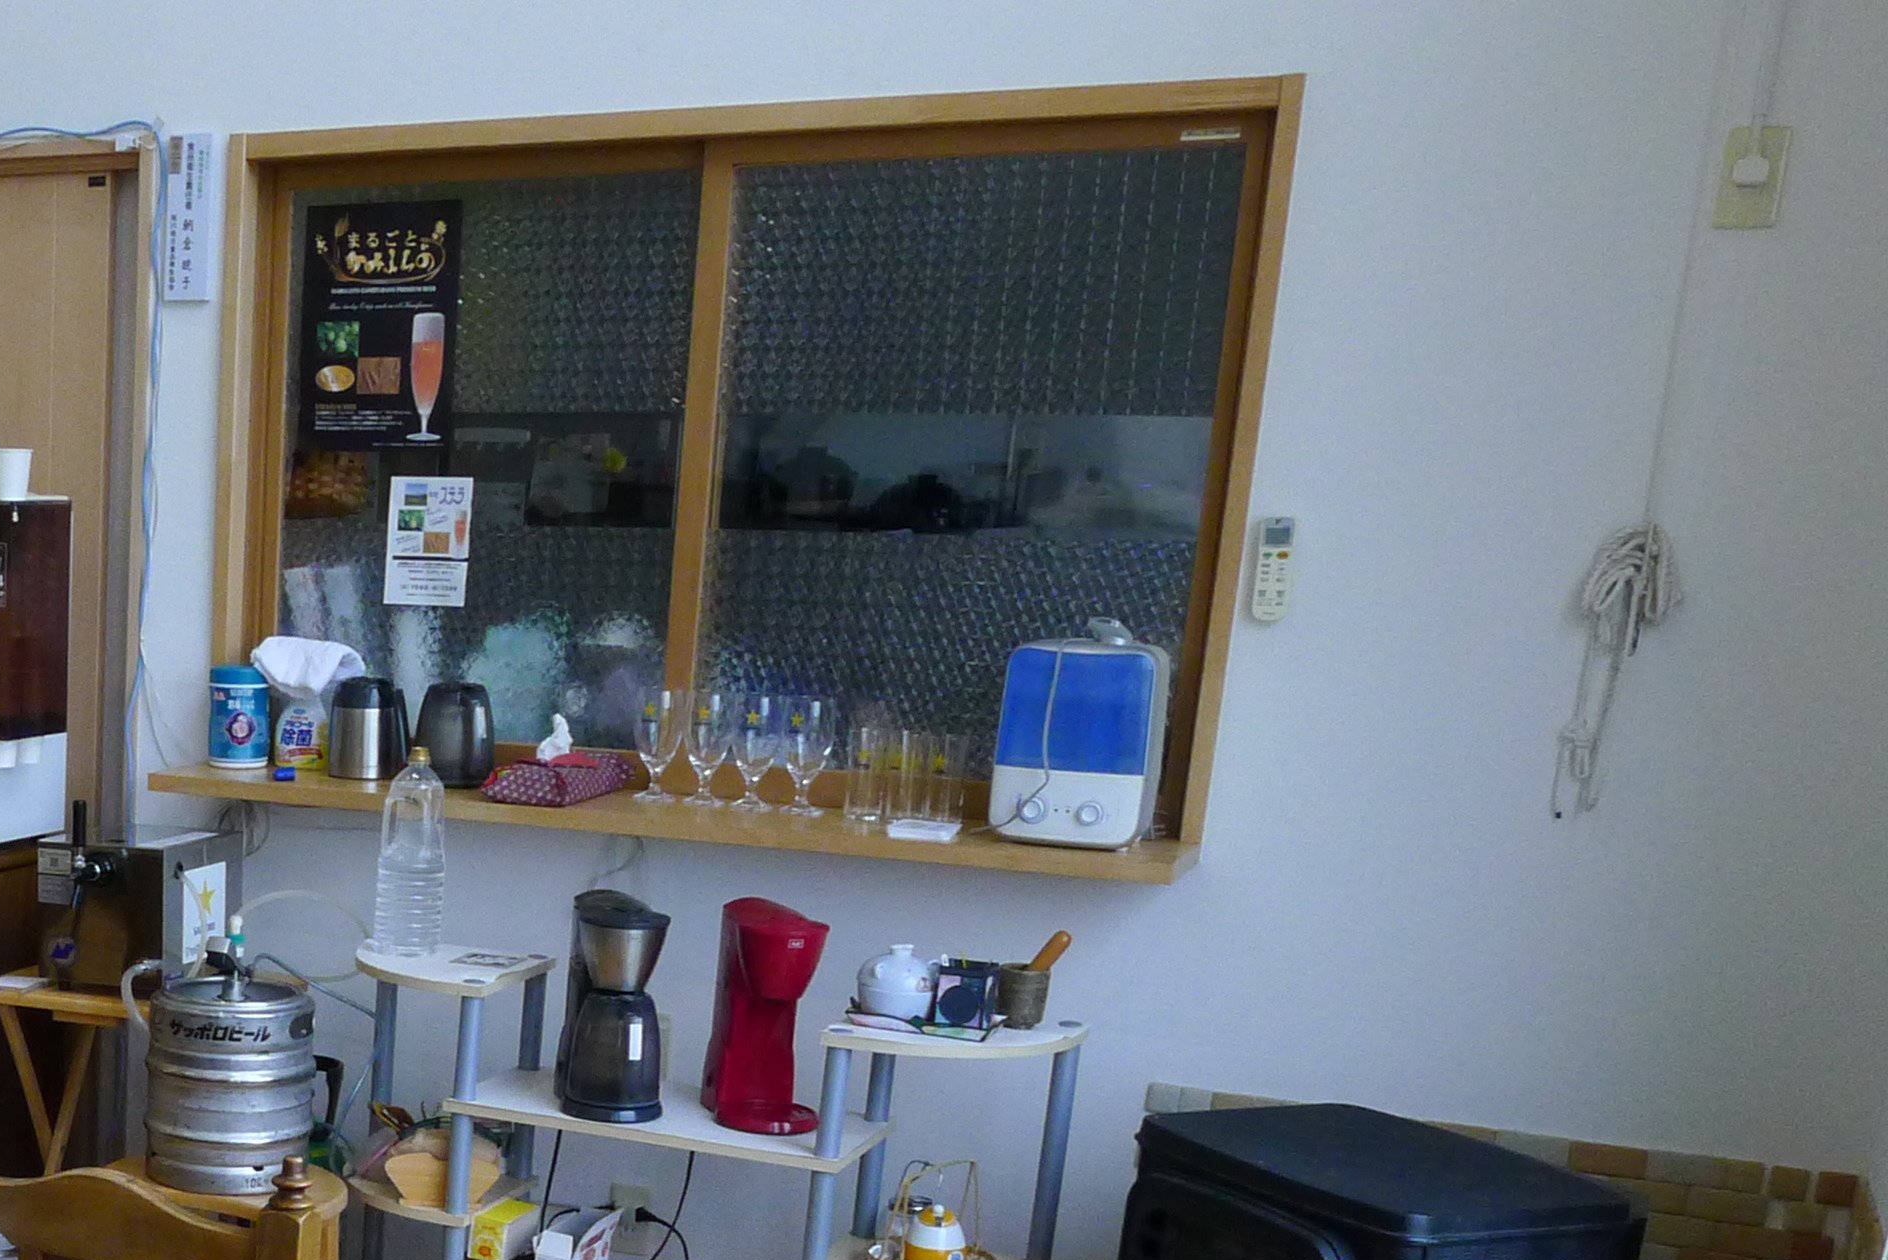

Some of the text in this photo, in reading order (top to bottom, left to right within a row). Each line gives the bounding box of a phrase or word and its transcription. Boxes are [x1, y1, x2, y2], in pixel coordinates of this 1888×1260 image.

[347, 229, 418, 249] まるごと
[280, 729, 314, 747] 除菌
[169, 1018, 272, 1043] サッポロビール
